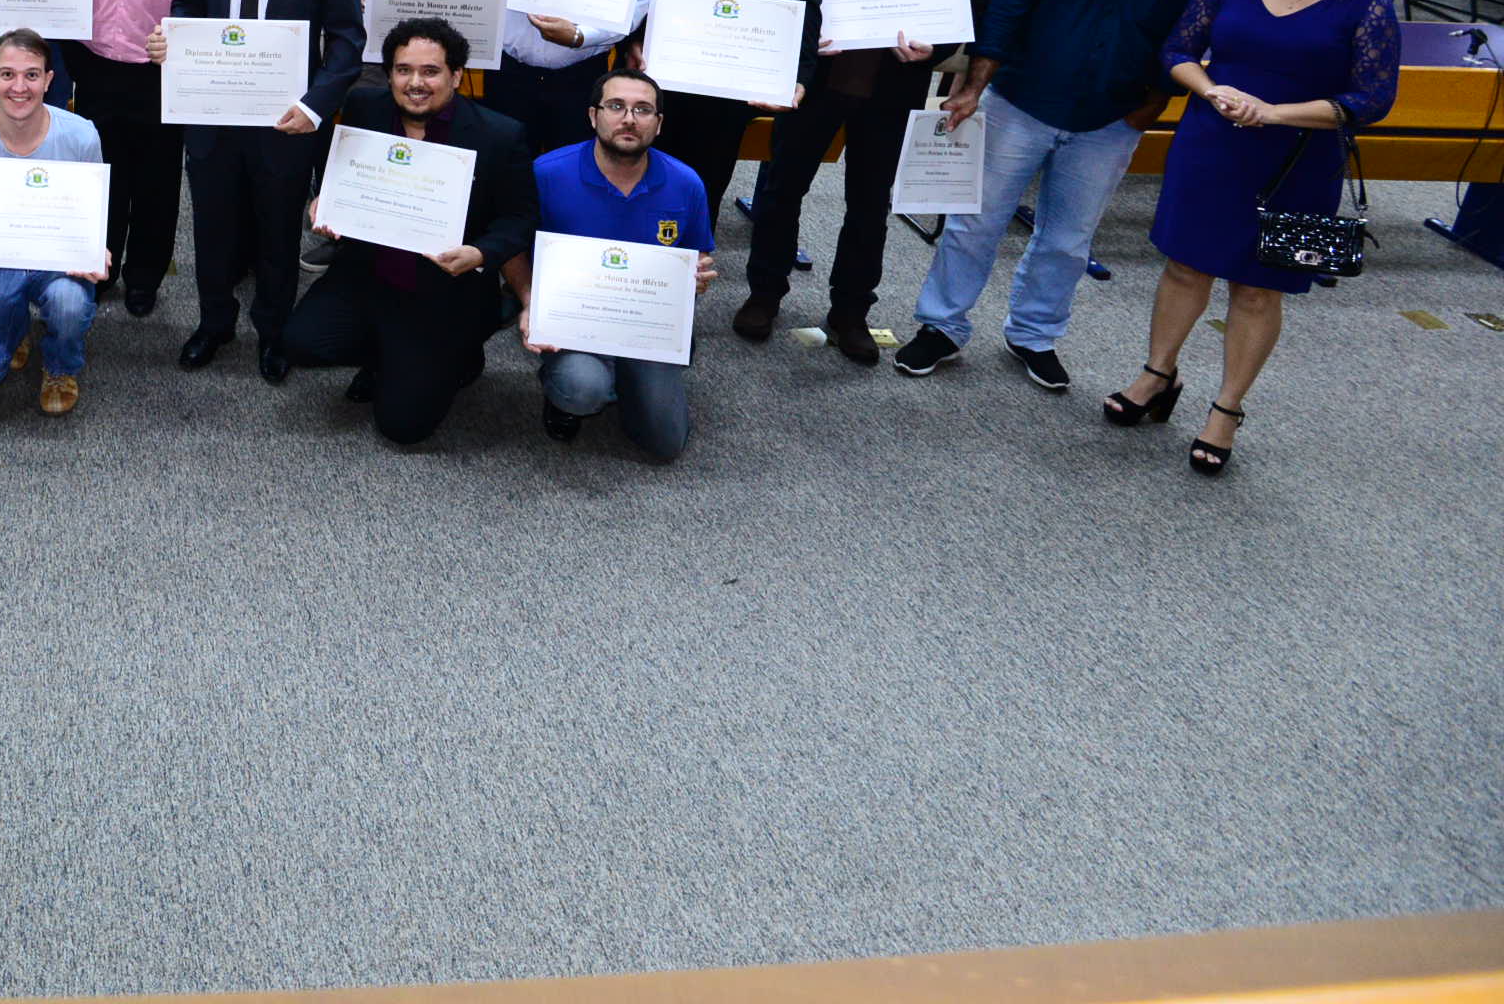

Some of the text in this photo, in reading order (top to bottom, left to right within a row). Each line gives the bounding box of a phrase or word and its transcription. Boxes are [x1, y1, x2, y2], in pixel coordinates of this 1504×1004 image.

[388, 0, 415, 7] Diploma
[460, 3, 483, 11] Mérito
[185, 48, 213, 57] Diploma
